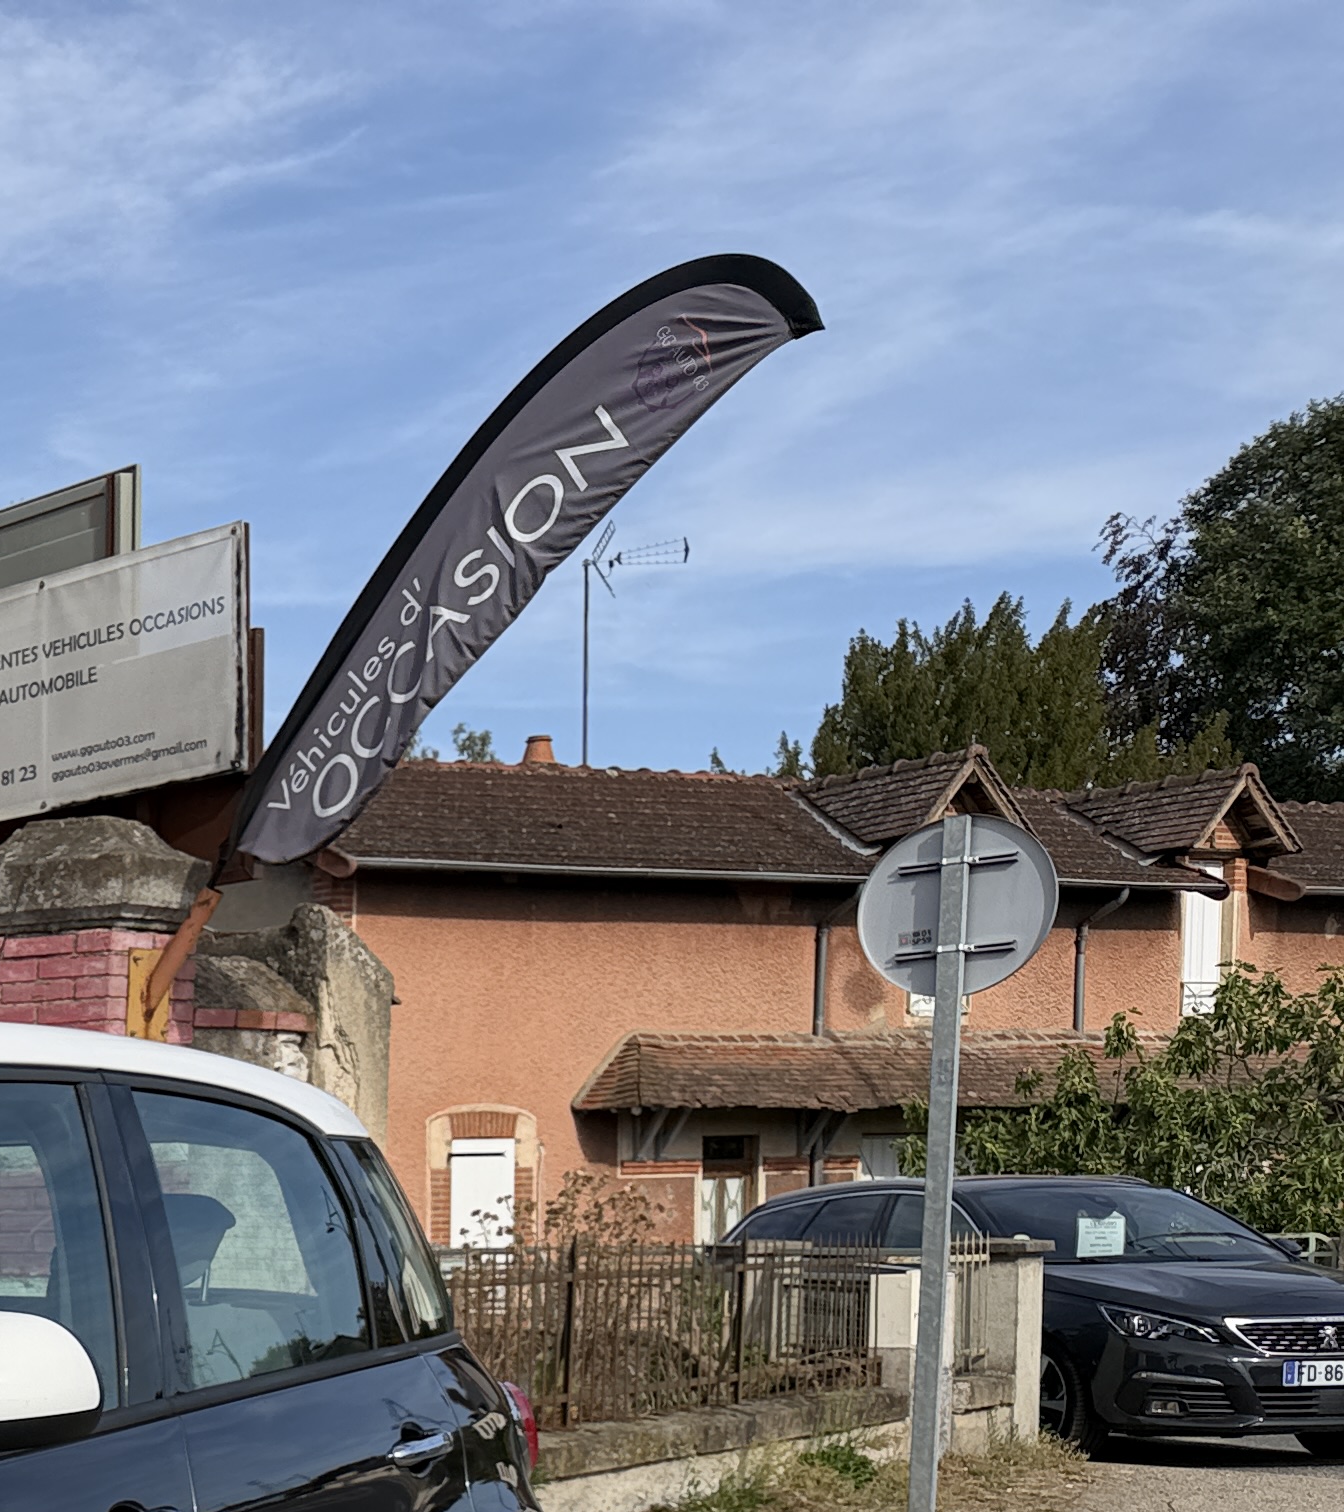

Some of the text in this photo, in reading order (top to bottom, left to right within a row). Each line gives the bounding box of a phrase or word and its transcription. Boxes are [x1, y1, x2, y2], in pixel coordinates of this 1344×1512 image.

[42, 622, 124, 659] VEHICULES
[129, 596, 225, 636] OCCASIONS
[312, 405, 629, 818] OCCASION
[51, 731, 156, 762] www.ggauto03.com
[266, 636, 397, 810] Véhicules
[0, 768, 15, 786] 81
[18, 764, 37, 783] 23
